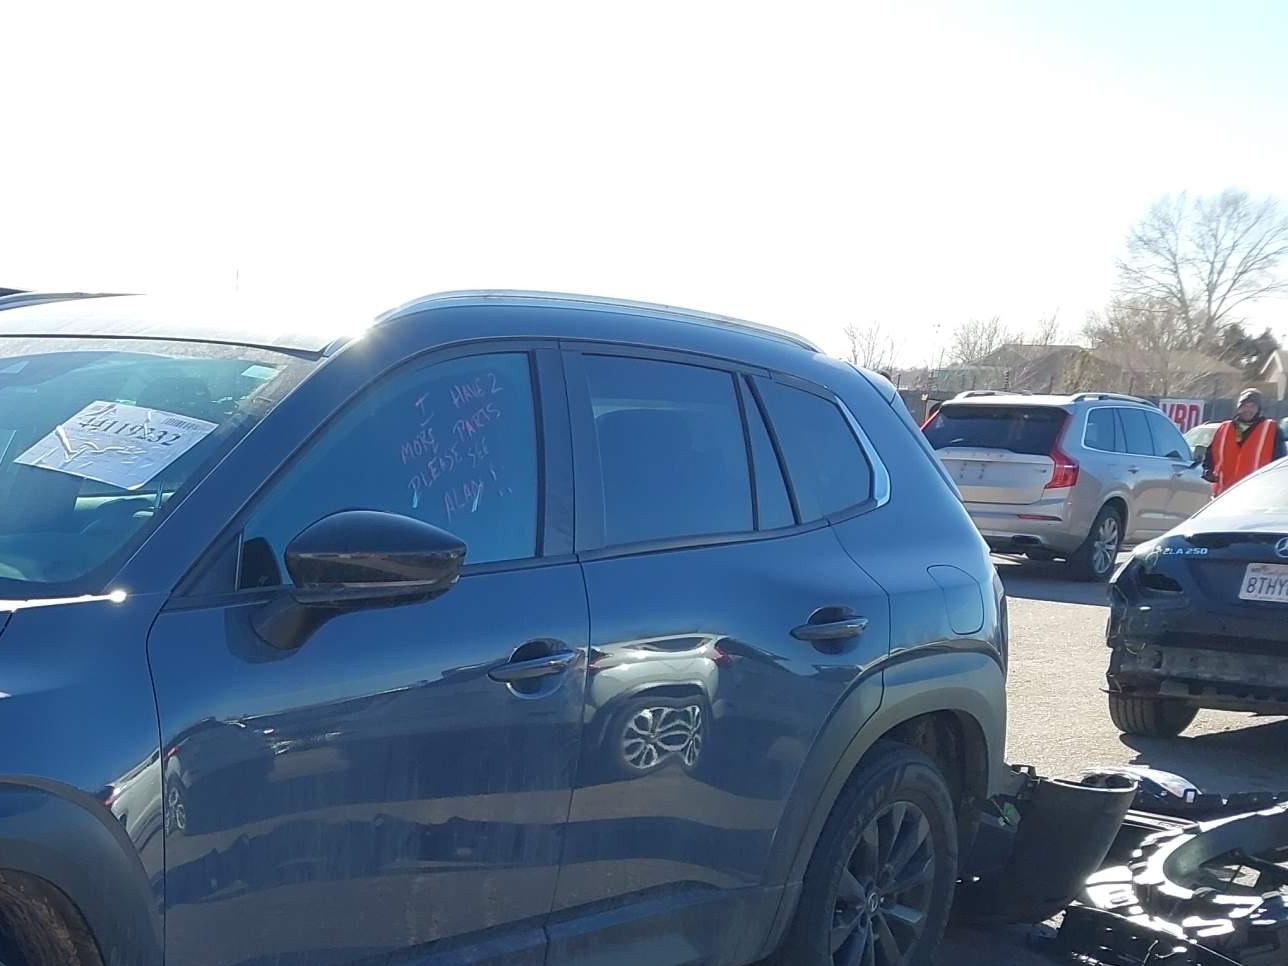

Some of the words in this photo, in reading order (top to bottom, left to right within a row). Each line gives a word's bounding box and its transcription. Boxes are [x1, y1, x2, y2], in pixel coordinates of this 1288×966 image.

[449, 377, 484, 408] HAVE
[488, 373, 503, 394] 2
[400, 427, 439, 464] MORE
[452, 403, 501, 441] PARTS
[408, 441, 463, 500] PLEASE
[468, 435, 489, 469] SEE
[1184, 547, 1209, 555] 250
[1246, 577, 1288, 597] 8THY
